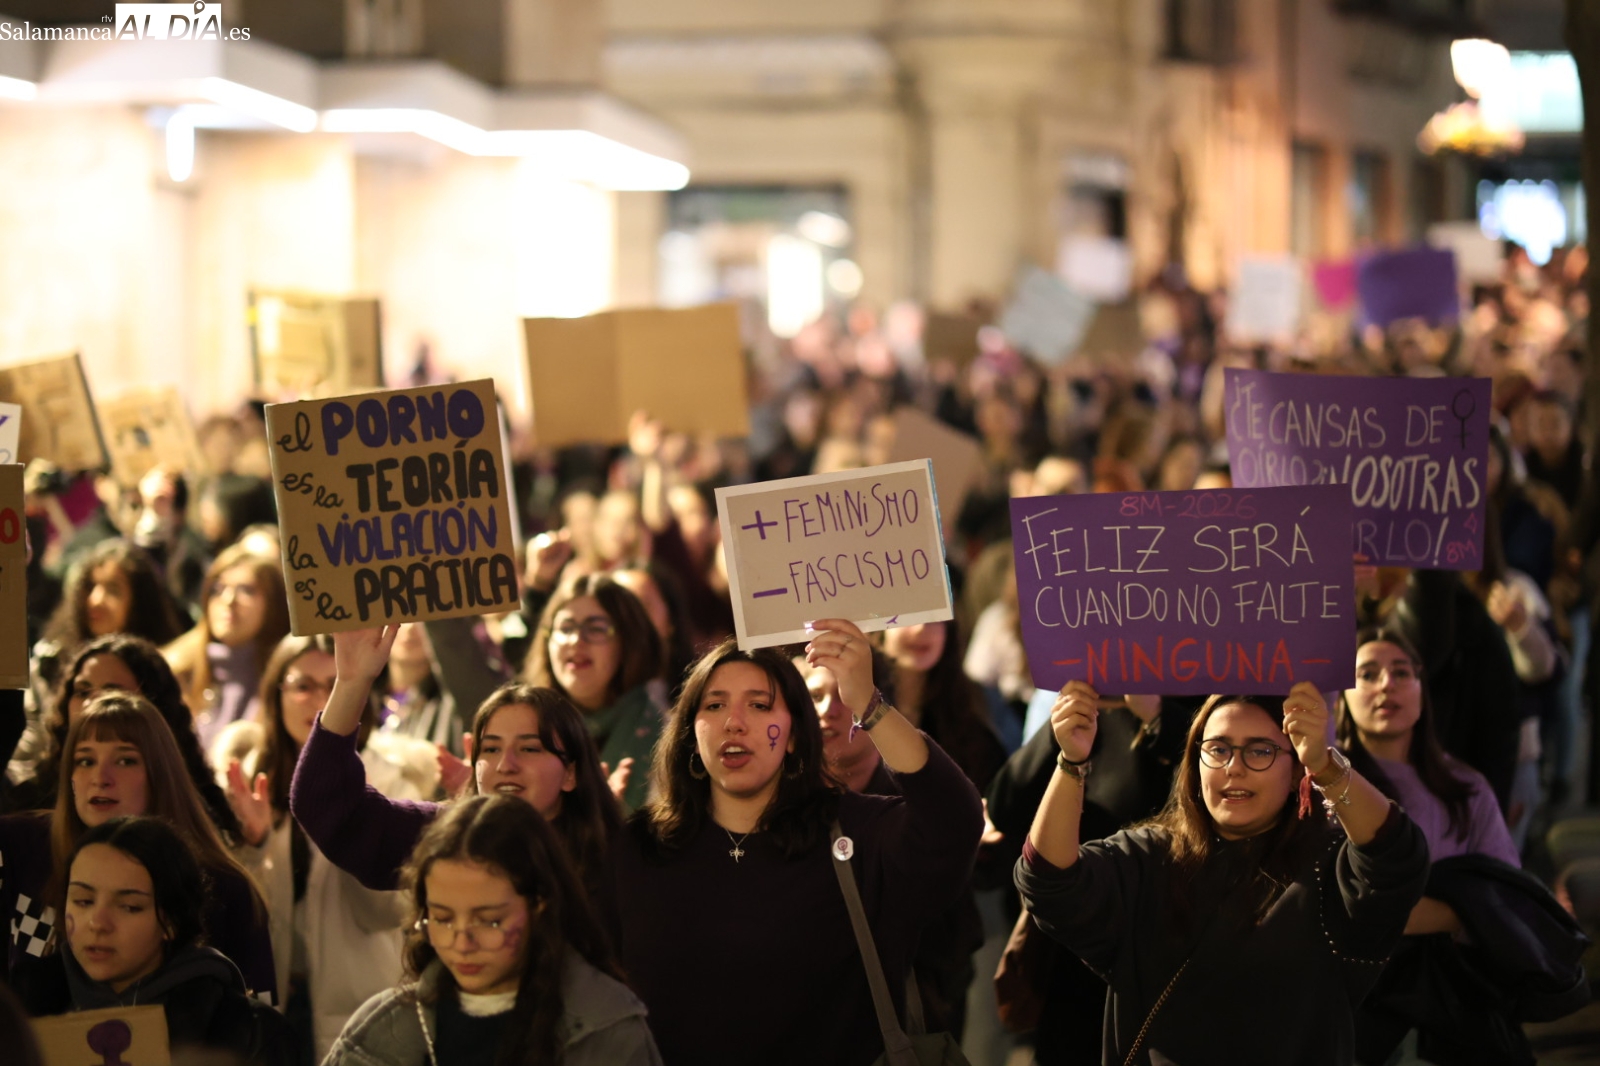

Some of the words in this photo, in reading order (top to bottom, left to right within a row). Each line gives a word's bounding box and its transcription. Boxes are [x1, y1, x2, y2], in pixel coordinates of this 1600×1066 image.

[276, 411, 313, 452] el
[321, 389, 485, 456] PORNO
[1268, 399, 1386, 449] CANSAS
[1405, 405, 1447, 447] DE
[280, 472, 314, 494] es
[313, 485, 344, 509] la
[346, 438, 499, 513] TEORÍA
[1119, 494, 1257, 519] 8M-2026
[288, 535, 318, 570] la
[1022, 507, 1169, 580] FELIZ
[1188, 506, 1314, 573] SERÁ
[1446, 540, 1477, 563] 8M
[294, 578, 317, 601] es
[315, 592, 352, 621] la
[354, 553, 519, 622] PRÁCTICA
[789, 549, 930, 604] FASCISMO
[1035, 581, 1168, 628] CUANDO
[1178, 584, 1221, 627] NO
[1232, 581, 1341, 624] FALTE
